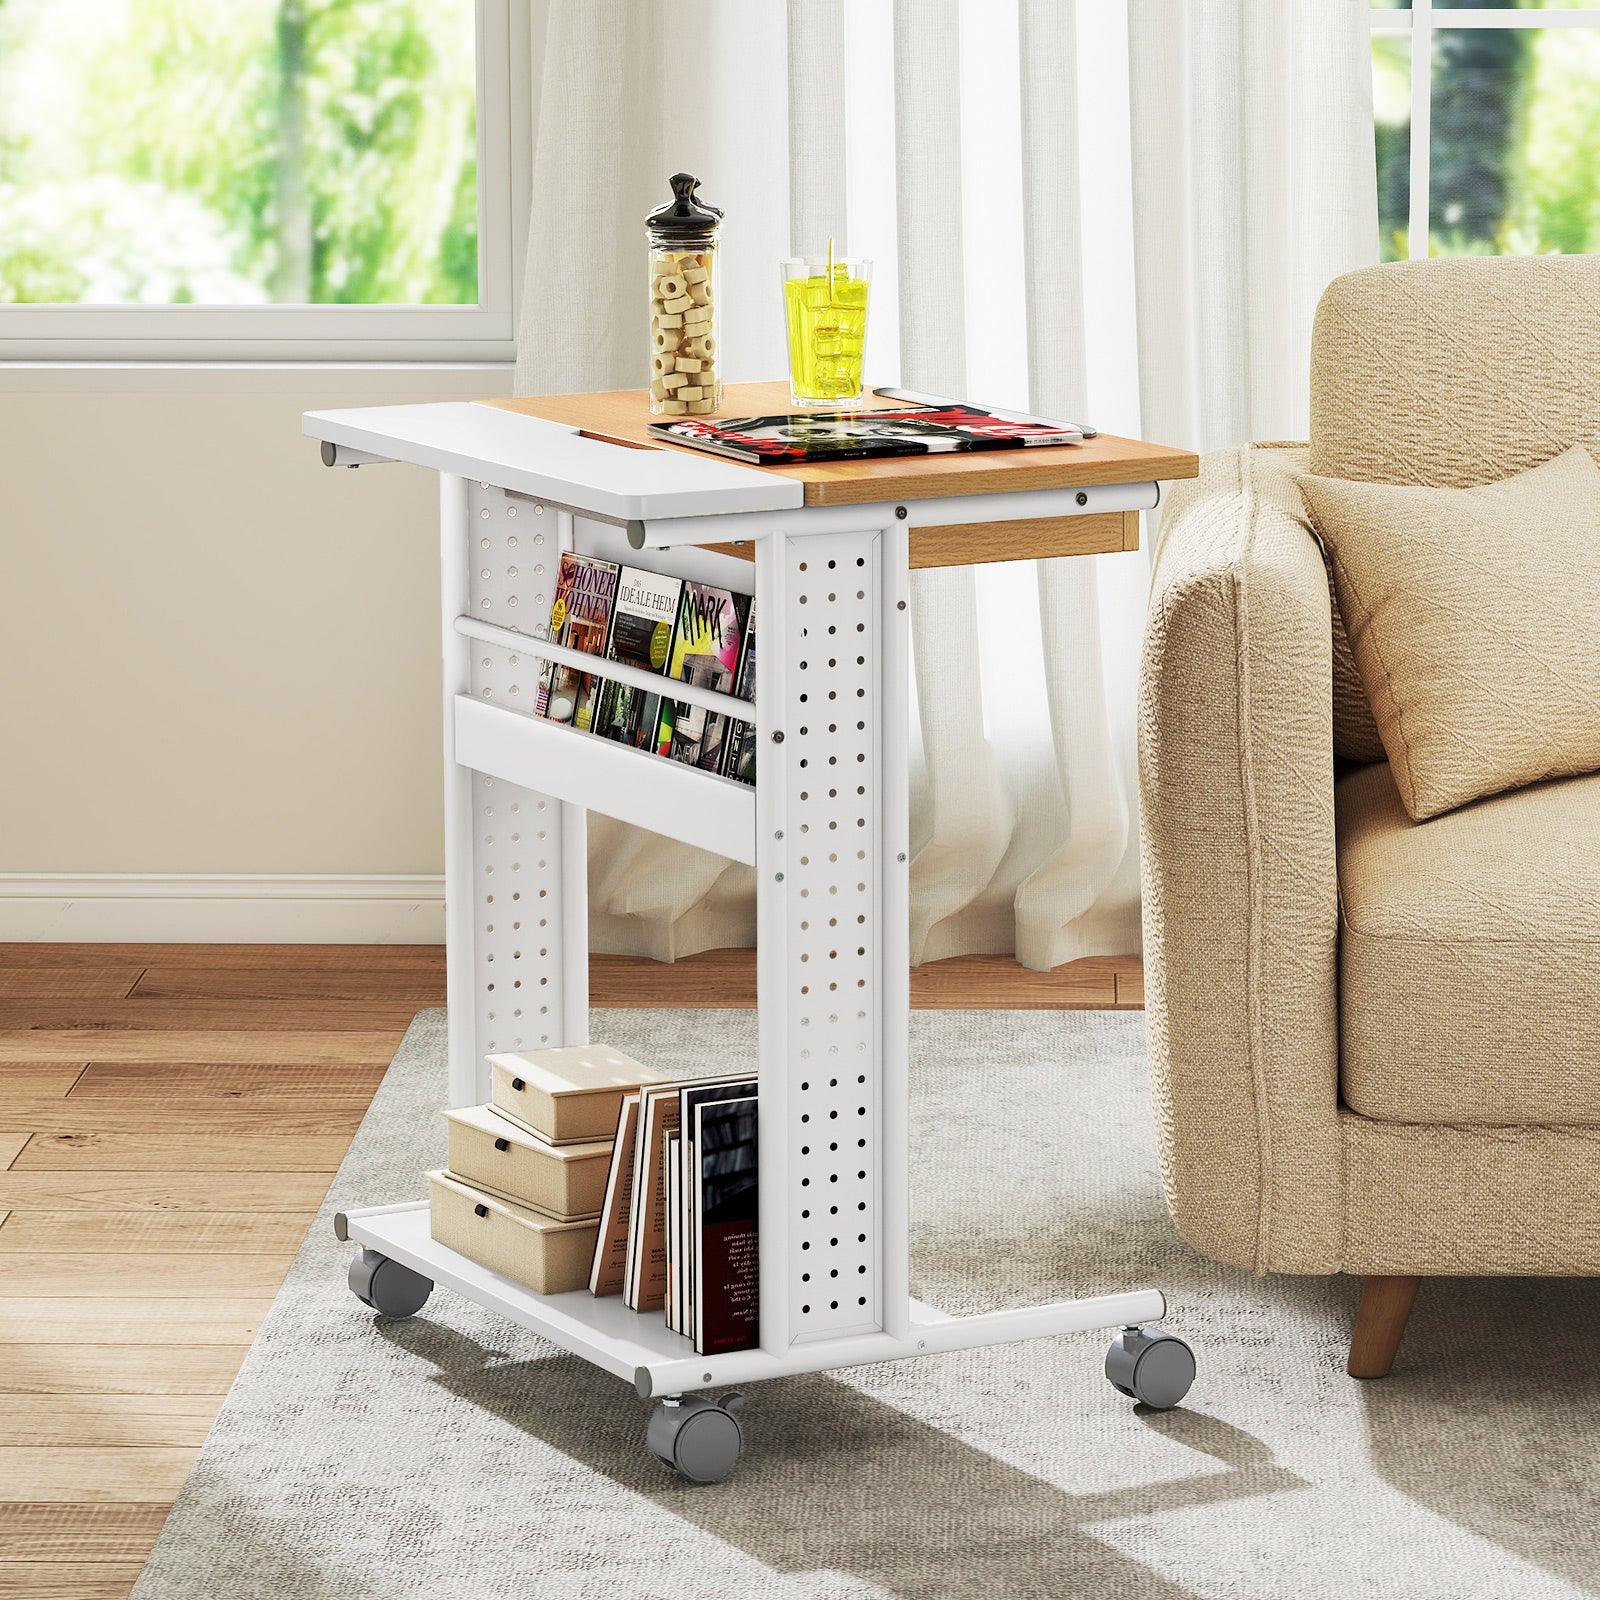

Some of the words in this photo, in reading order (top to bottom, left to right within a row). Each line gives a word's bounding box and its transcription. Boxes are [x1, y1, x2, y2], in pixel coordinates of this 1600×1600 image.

[558, 561, 617, 598] SCHÖNER
[619, 585, 651, 607] IDEALE
[651, 592, 676, 614] HEIM
[682, 590, 727, 649] MARK
